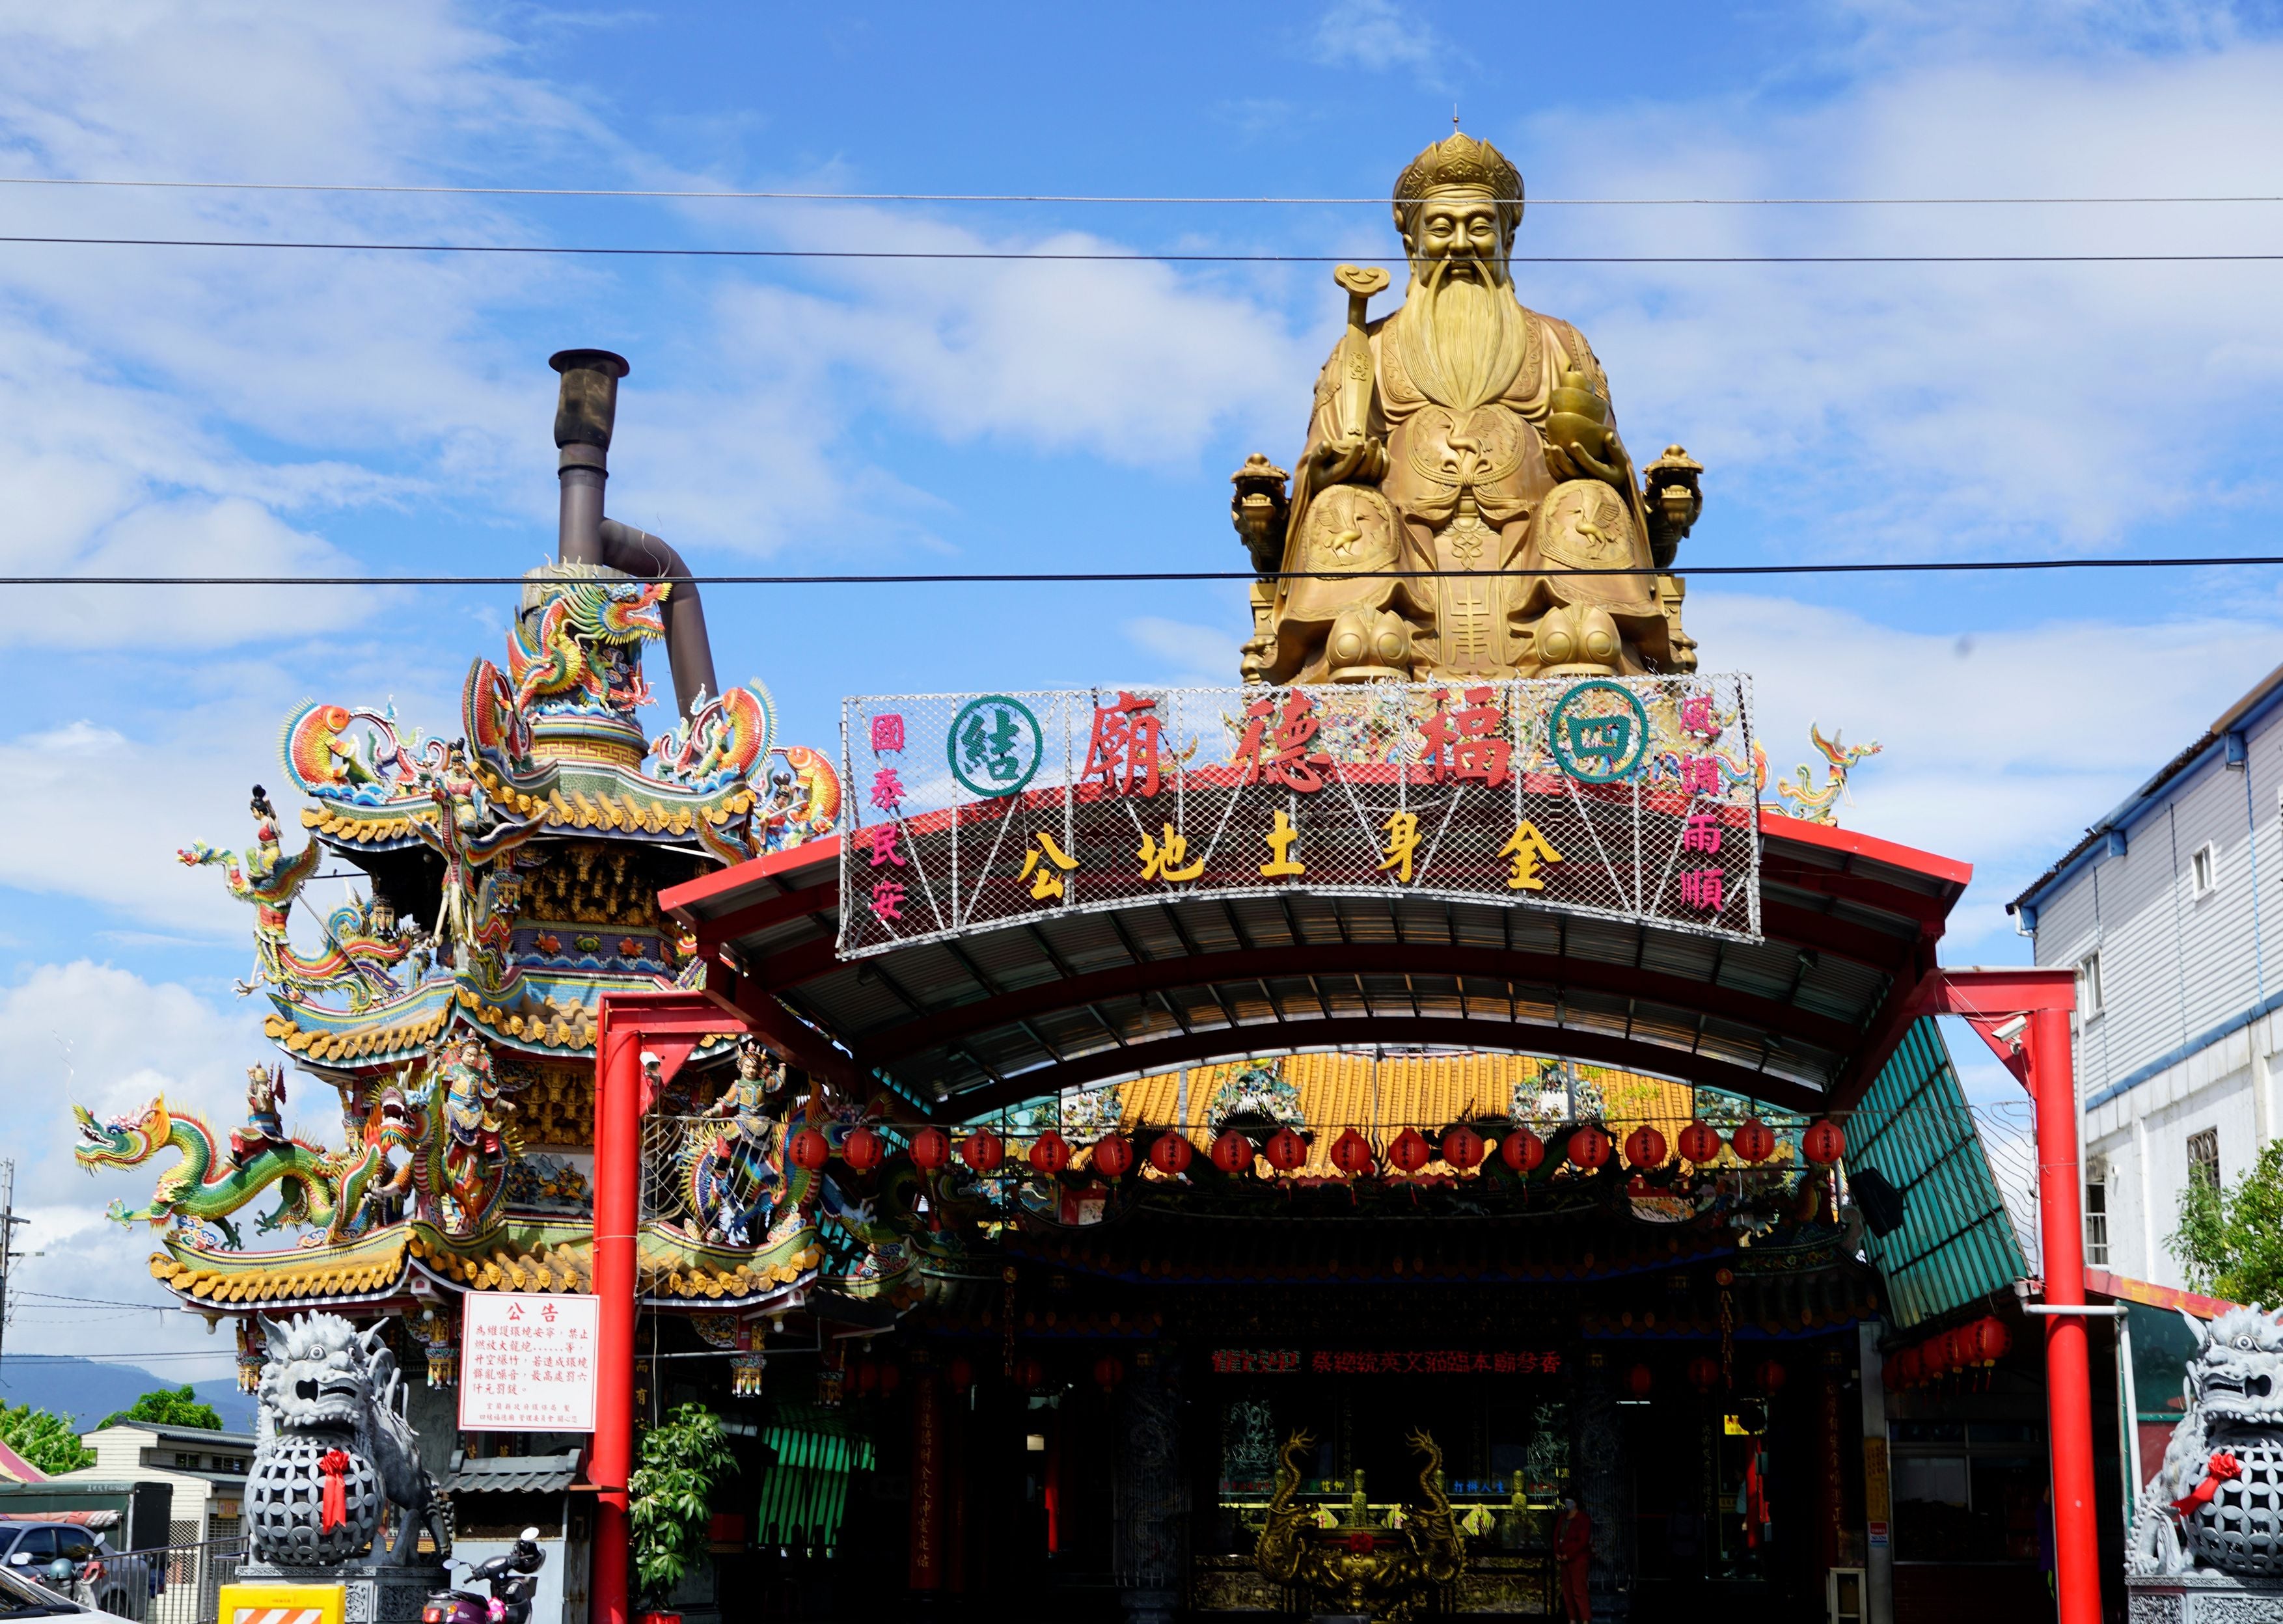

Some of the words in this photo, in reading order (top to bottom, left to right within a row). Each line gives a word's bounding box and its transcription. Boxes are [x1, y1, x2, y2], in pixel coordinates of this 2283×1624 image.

[869, 714, 906, 922] 國泰民安
[1678, 696, 1724, 912] 風調雨順
[506, 1301, 559, 1323] 公告
